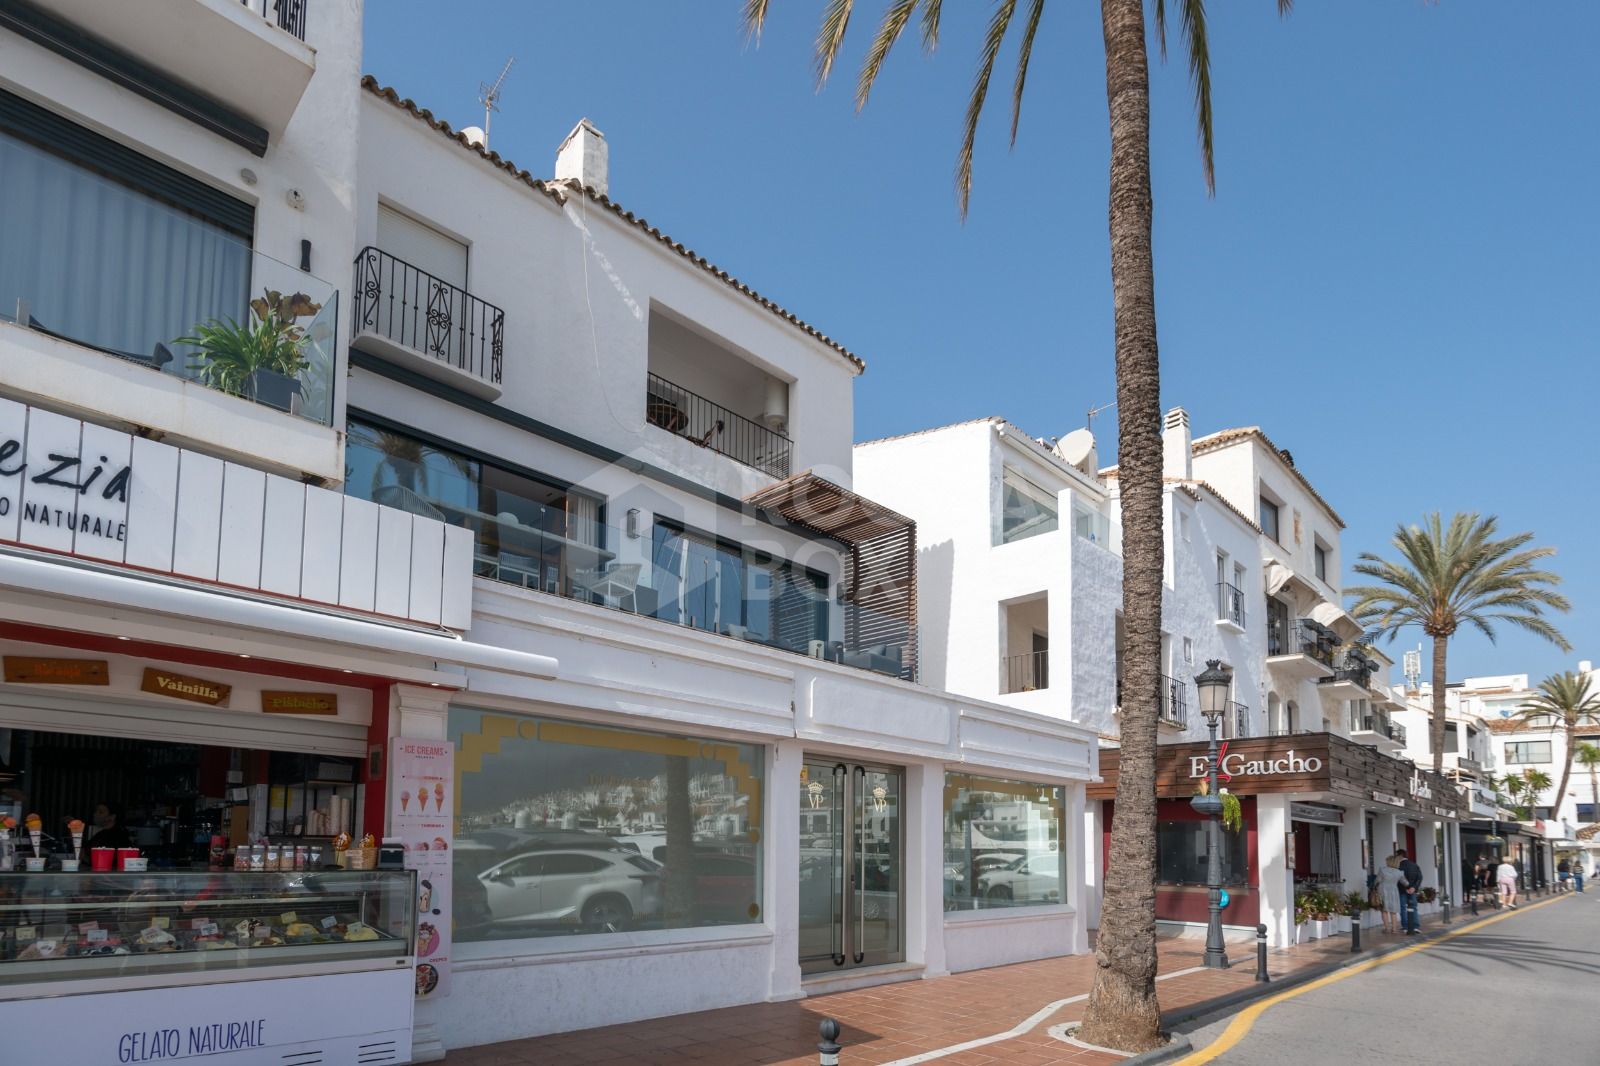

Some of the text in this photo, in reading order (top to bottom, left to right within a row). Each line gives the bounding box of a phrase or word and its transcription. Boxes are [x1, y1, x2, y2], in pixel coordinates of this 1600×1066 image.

[24, 502, 126, 541] NATURALE
[157, 676, 220, 699] Vainilla
[404, 744, 444, 756] ICE CREAMS
[1222, 750, 1322, 776] Gaucho
[118, 1019, 266, 1063] GELATO NATURALE
